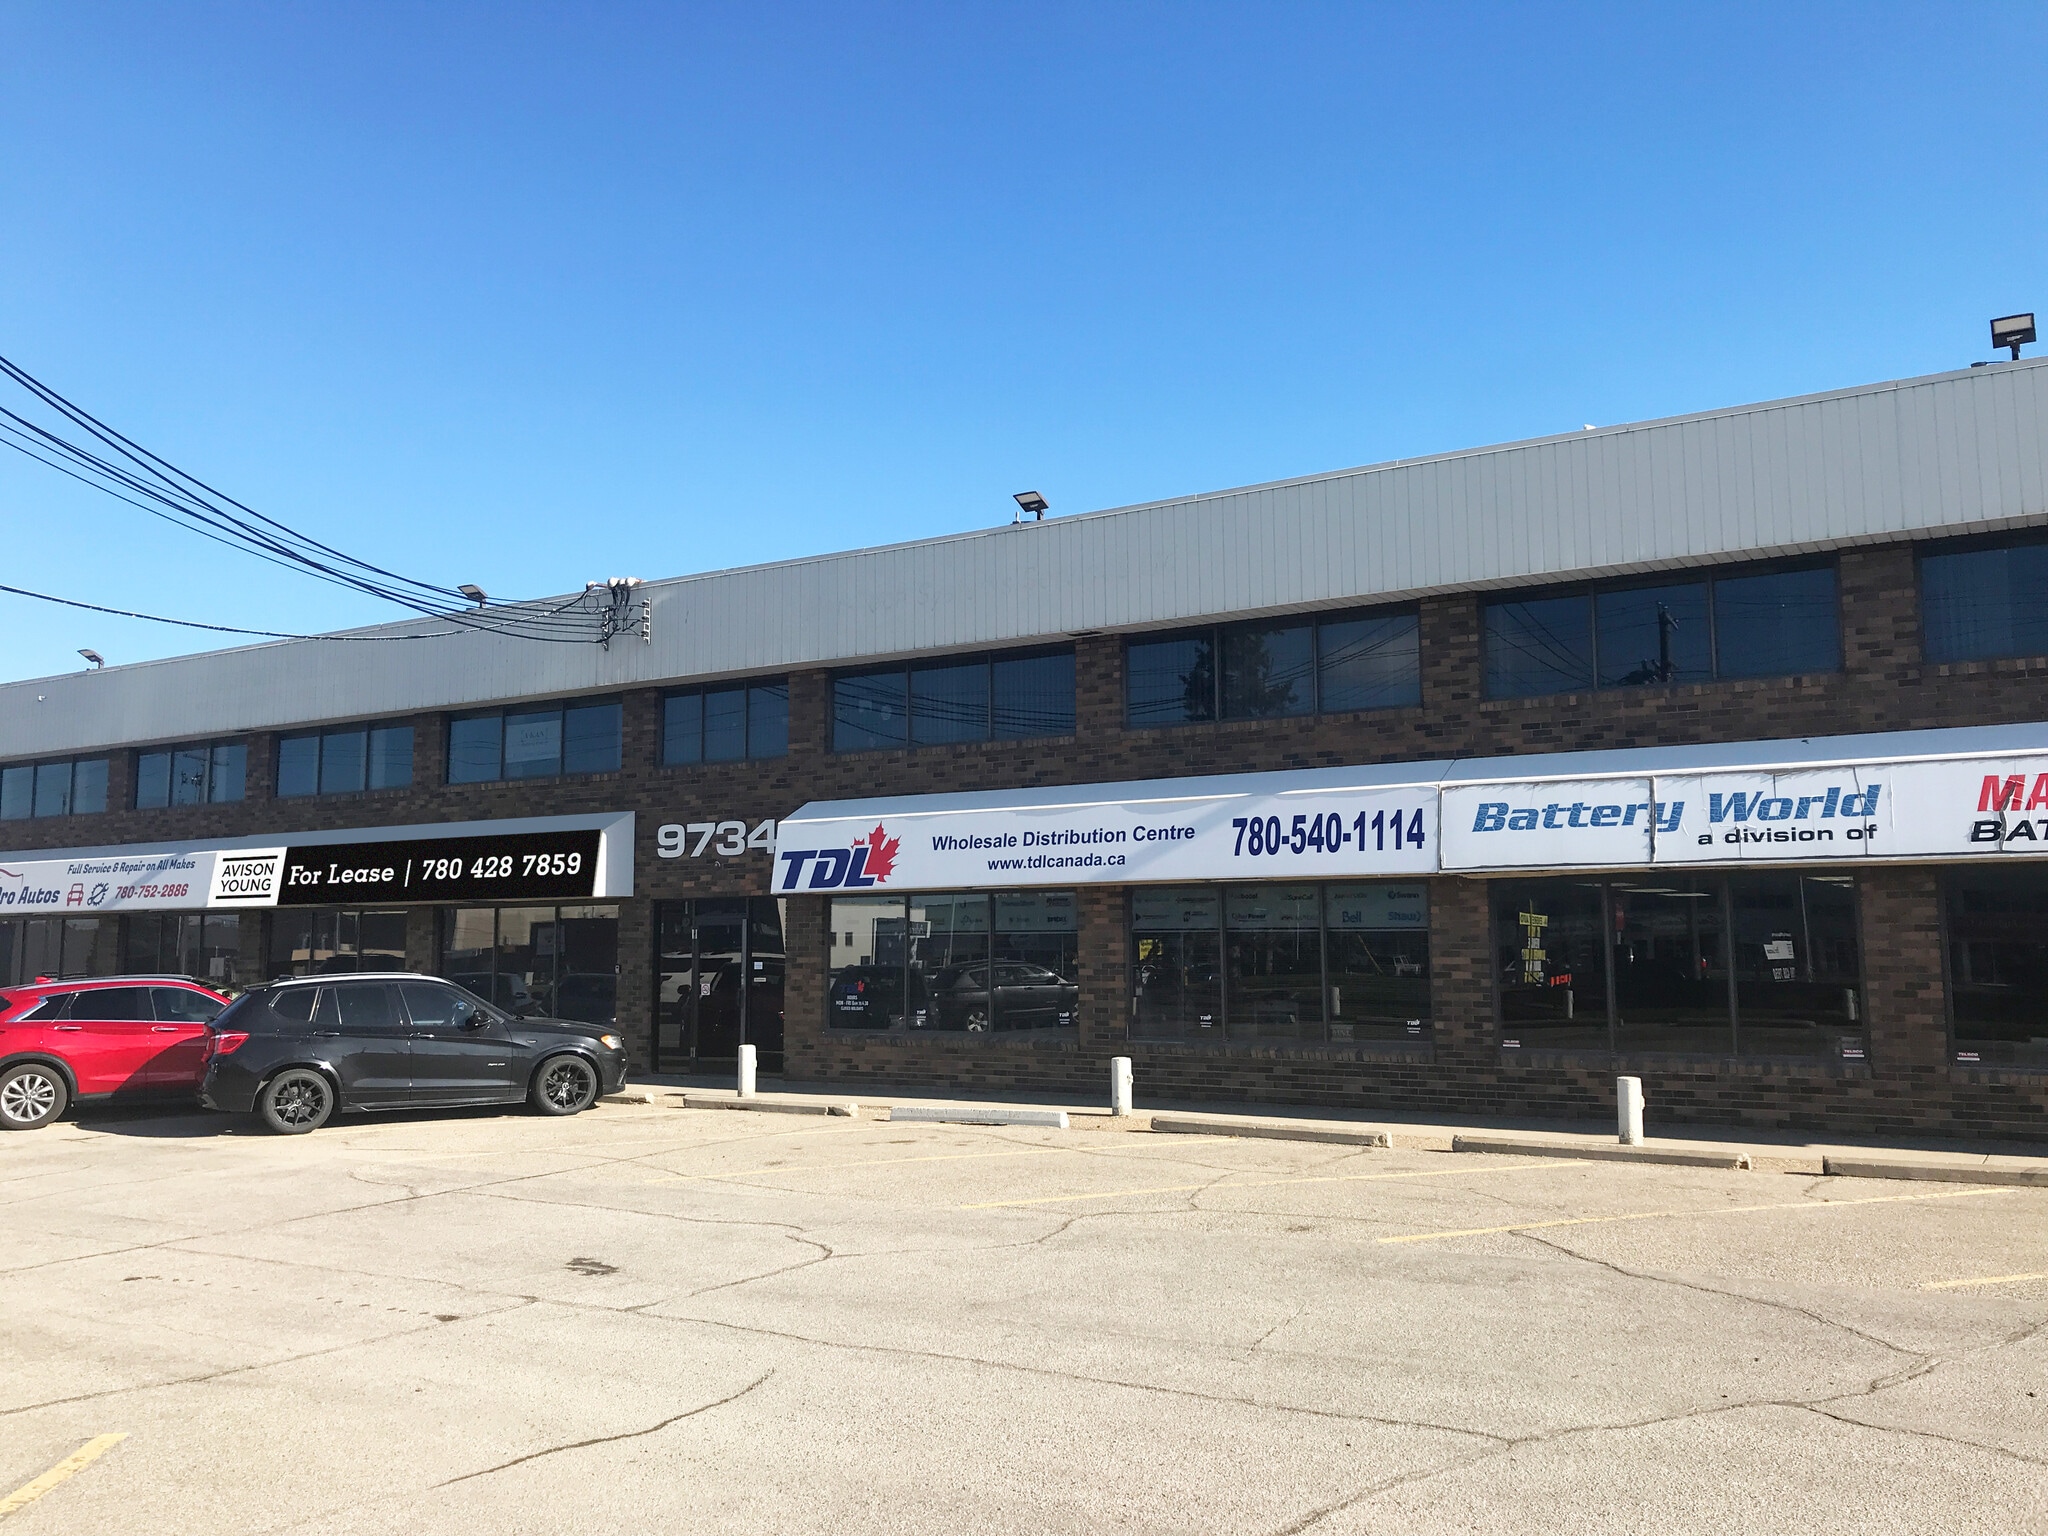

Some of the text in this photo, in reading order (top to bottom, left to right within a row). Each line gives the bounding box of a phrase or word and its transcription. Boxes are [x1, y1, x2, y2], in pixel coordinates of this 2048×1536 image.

[1471, 784, 1881, 834] Battery World
[657, 818, 777, 859] 9734
[932, 822, 1196, 852] Wholesale Distribution Centre
[1232, 808, 1426, 857] 780-540-1114
[1697, 823, 1878, 845] a division of
[67, 858, 196, 875] Full Service & Repair on All Makes
[222, 862, 275, 878] AVISON
[288, 865, 322, 886] For
[327, 863, 394, 884] Lease
[422, 858, 462, 880] 780
[470, 856, 512, 879] 428
[522, 852, 581, 877] 7859
[780, 845, 878, 890] TDL
[986, 854, 1126, 872] www.tdlcanada.ca
[115, 883, 189, 900] 780-752-2886
[221, 877, 271, 893] YOUNG
[17, 886, 61, 905] Autos
[1342, 911, 1362, 923] Bell
